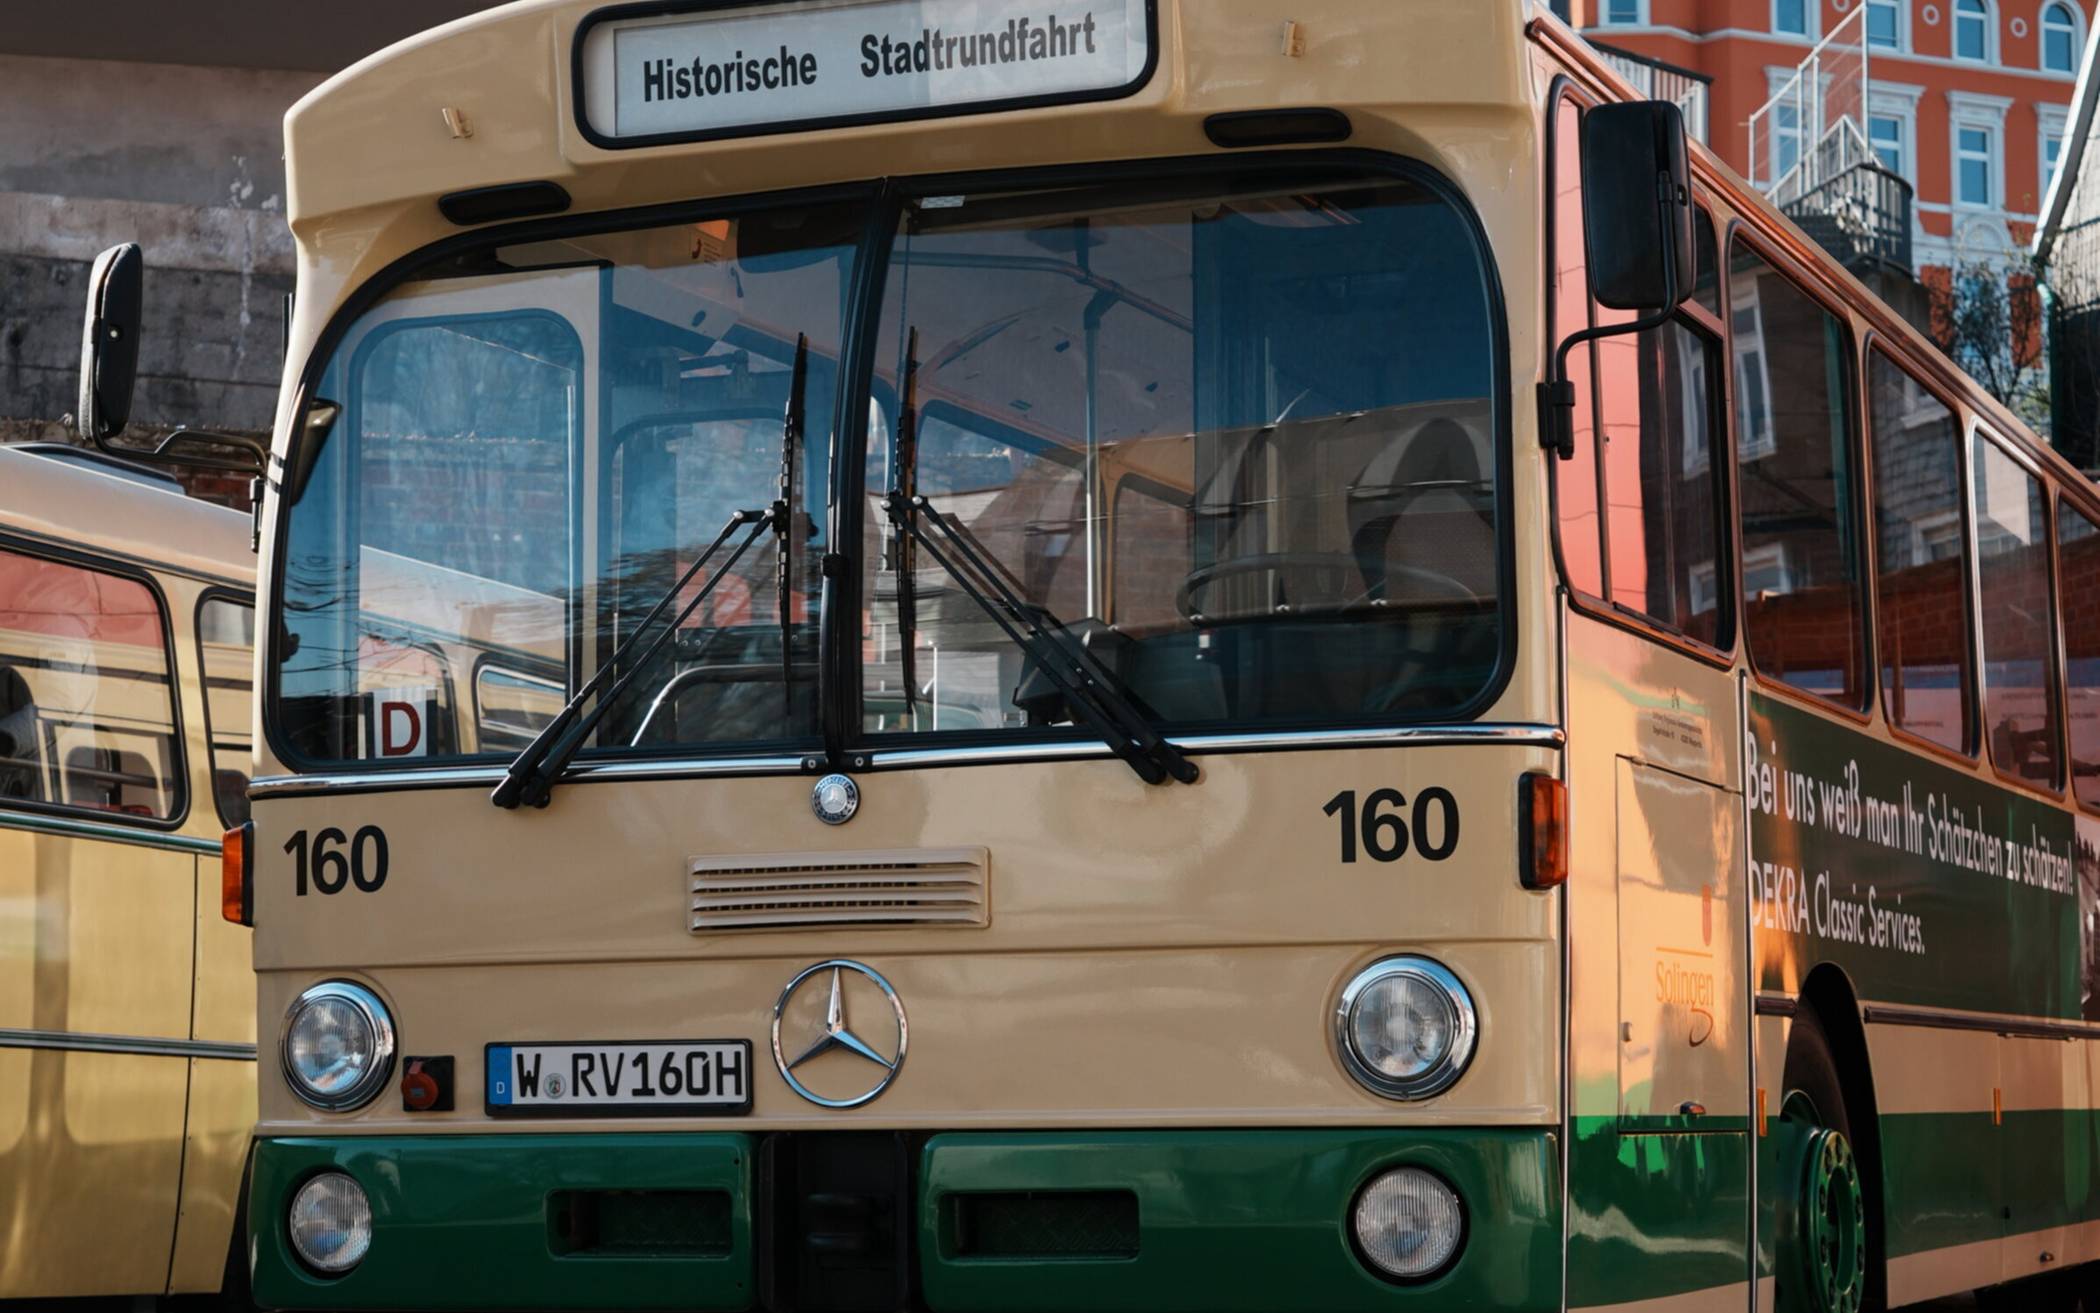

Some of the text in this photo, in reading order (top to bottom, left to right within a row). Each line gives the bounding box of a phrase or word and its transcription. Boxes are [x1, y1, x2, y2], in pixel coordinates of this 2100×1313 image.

[643, 12, 1096, 102] Historische Stadtrundfahrt
[381, 701, 421, 756] D
[1322, 786, 1460, 863] 160
[1747, 731, 2074, 896] Bei uns weiß man Ihr Schätzchen zu schätzen!
[283, 825, 389, 896] 160
[1749, 859, 1926, 954] DEKRA Classic Services.
[1655, 961, 1714, 1047] Solingen
[496, 1081, 505, 1094] D
[516, 1053, 542, 1098] W
